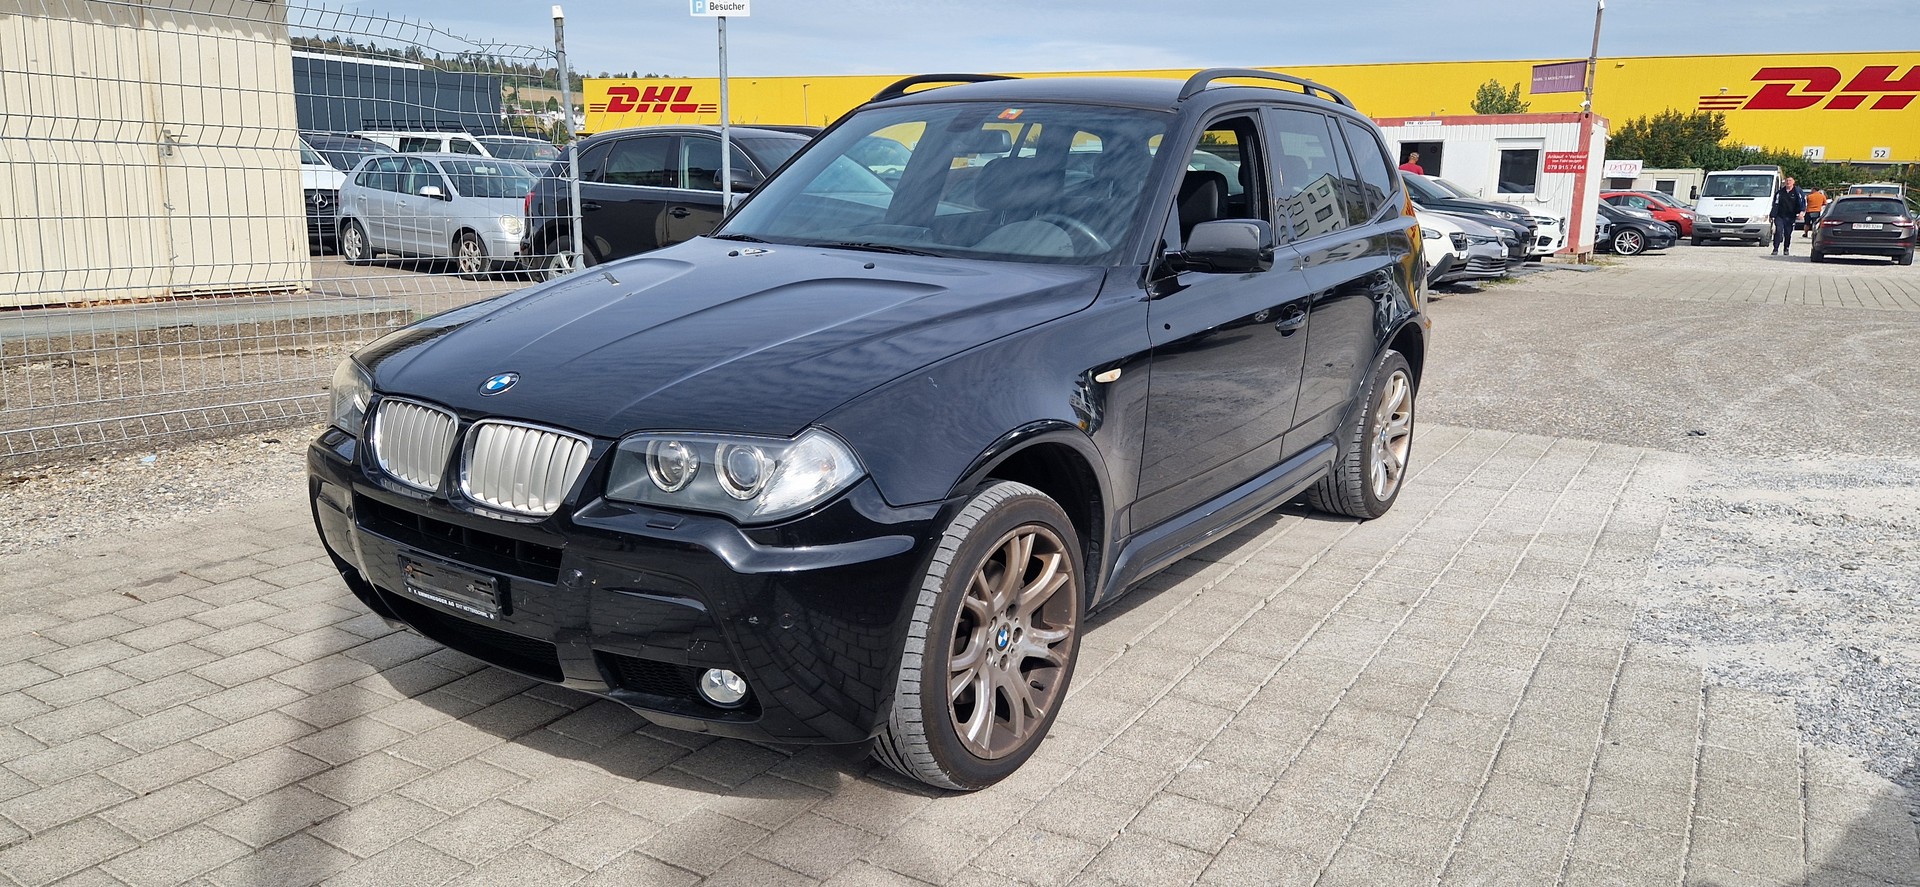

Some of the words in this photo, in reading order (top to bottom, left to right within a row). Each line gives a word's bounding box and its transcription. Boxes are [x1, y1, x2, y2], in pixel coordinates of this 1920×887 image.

[709, 2, 745, 10] Besucher
[606, 86, 699, 113] DHL
[1808, 148, 1819, 157] 51
[1873, 149, 1886, 158] 52
